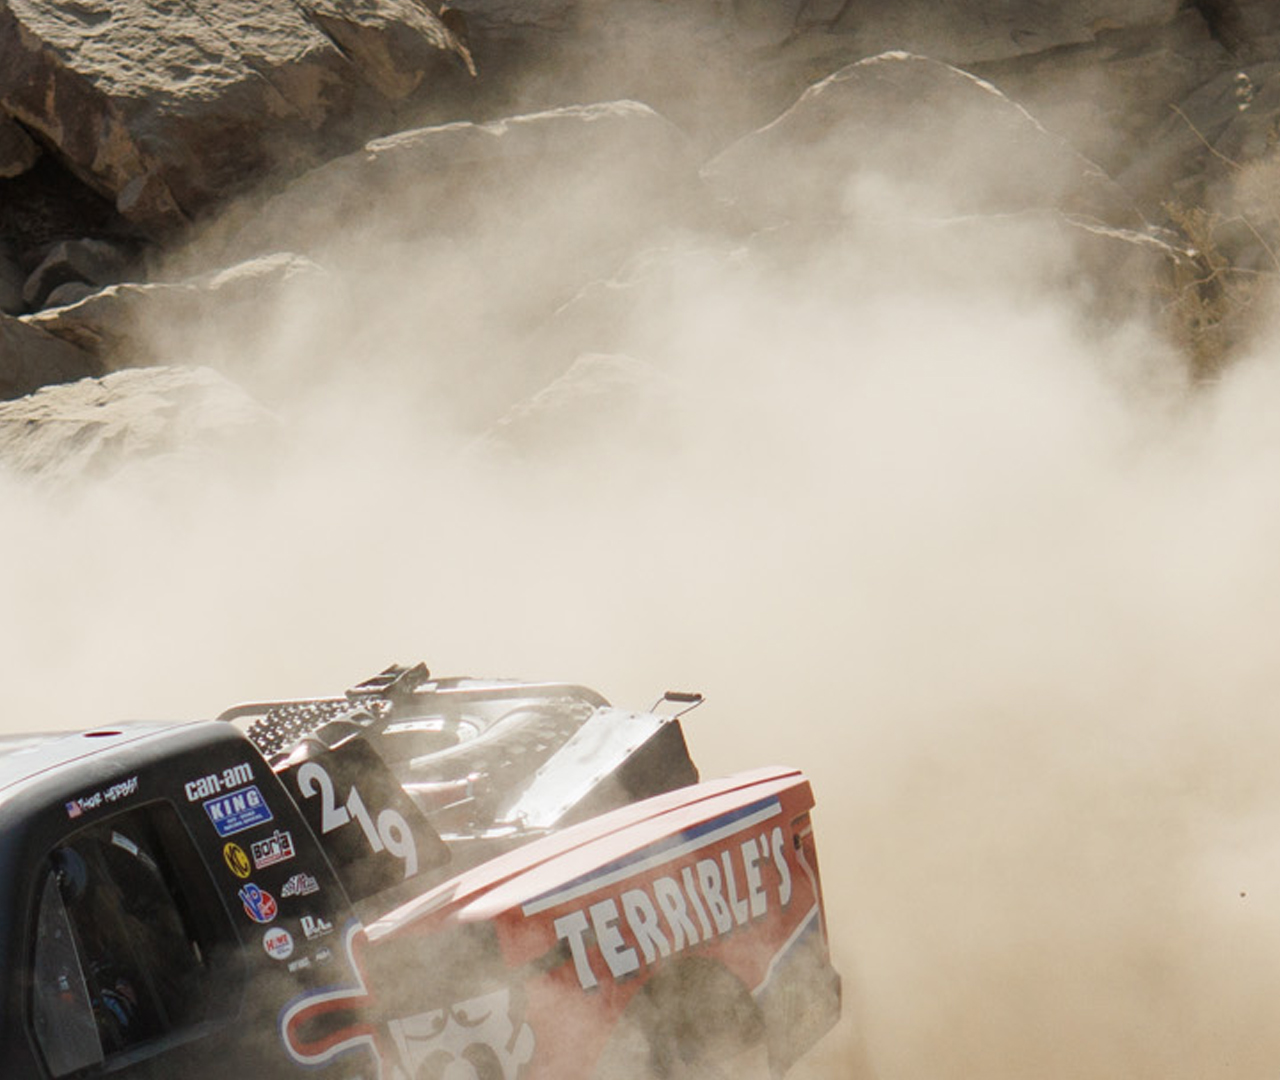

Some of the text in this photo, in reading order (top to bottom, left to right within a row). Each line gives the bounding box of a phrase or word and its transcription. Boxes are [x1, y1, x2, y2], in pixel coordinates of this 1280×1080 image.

[184, 762, 255, 801] can-am
[210, 790, 260, 820] KING
[297, 762, 418, 879] 219
[554, 826, 791, 990] TERRIBLE'S
